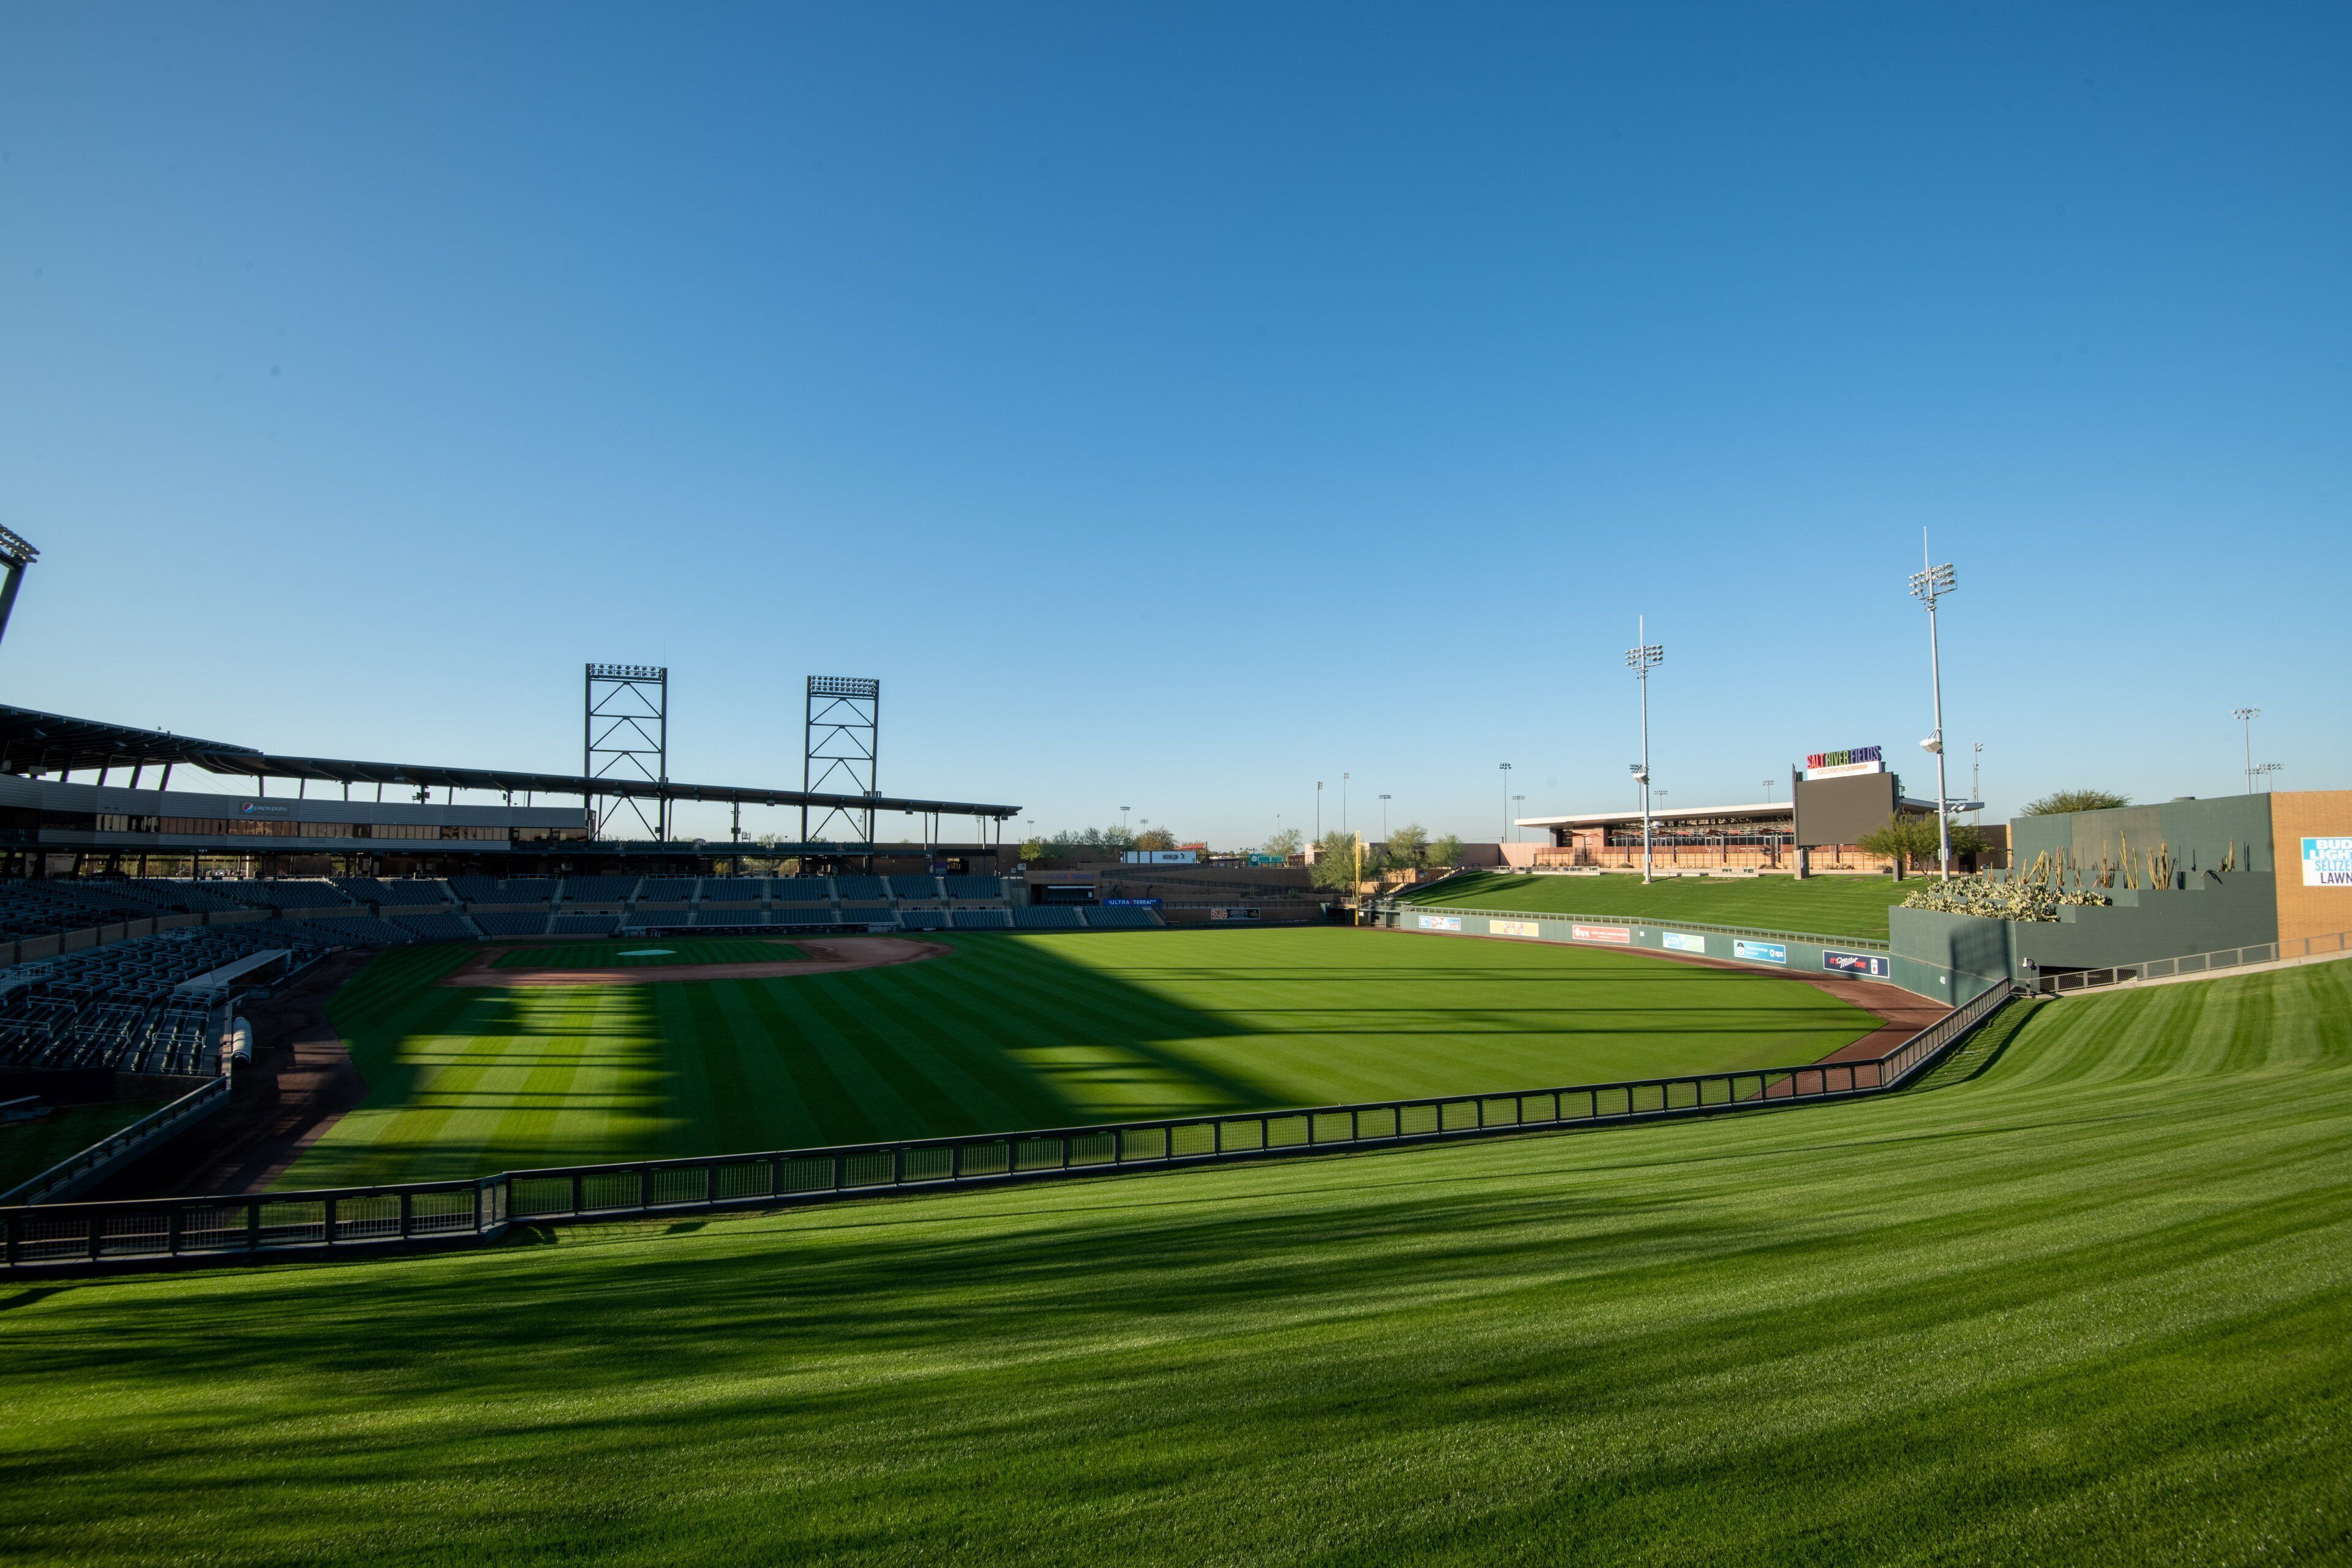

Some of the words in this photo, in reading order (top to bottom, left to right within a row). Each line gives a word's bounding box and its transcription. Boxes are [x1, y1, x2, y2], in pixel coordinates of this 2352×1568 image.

[1807, 753, 1825, 769] SALT
[1825, 750, 1849, 766] RIVER
[1850, 745, 1881, 764] FIELDS
[2316, 839, 2352, 850] BUD
[2320, 872, 2352, 883] LAWN
[1837, 957, 1858, 968] Miller
